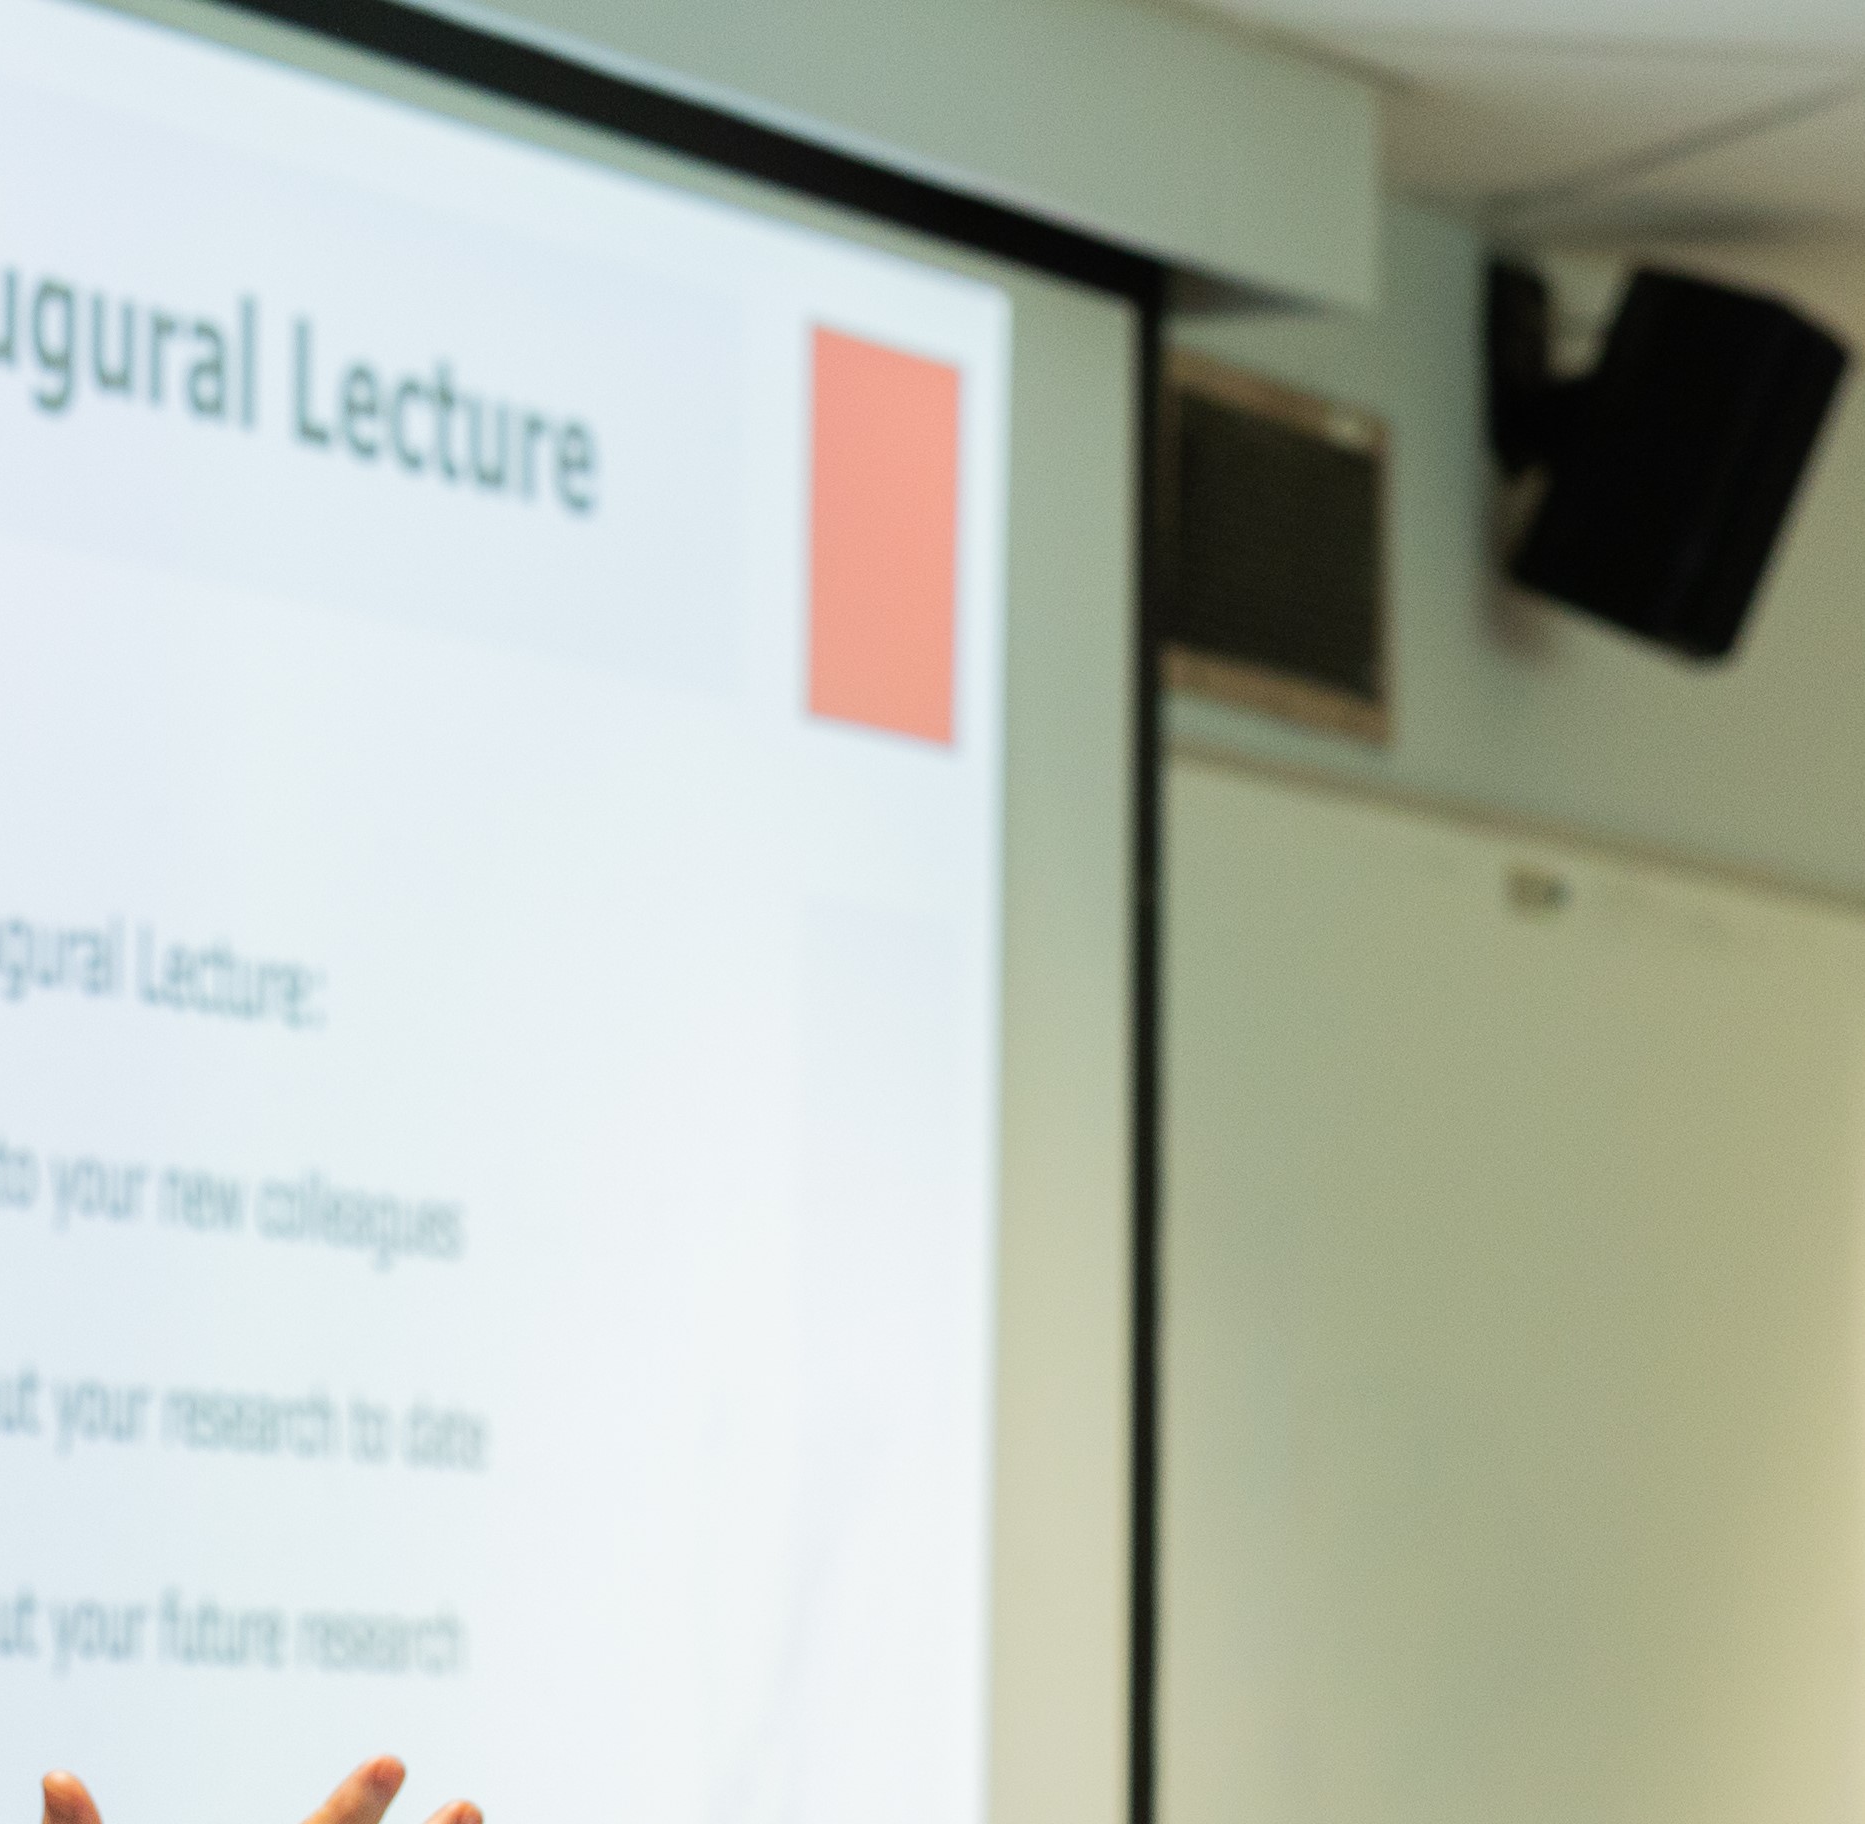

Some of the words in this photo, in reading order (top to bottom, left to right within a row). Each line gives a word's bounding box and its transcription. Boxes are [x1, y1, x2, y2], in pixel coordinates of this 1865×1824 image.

[291, 314, 601, 518] Lecture
[136, 920, 328, 1032] Lecture:
[52, 1152, 148, 1234] your
[158, 1164, 245, 1234] new
[256, 1167, 468, 1272] colleagues
[52, 1375, 151, 1459] your
[160, 1376, 340, 1462] research
[349, 1392, 391, 1463] to
[401, 1388, 492, 1475] date
[47, 1596, 151, 1680] your
[156, 1582, 285, 1673] future
[296, 1595, 471, 1678] research
